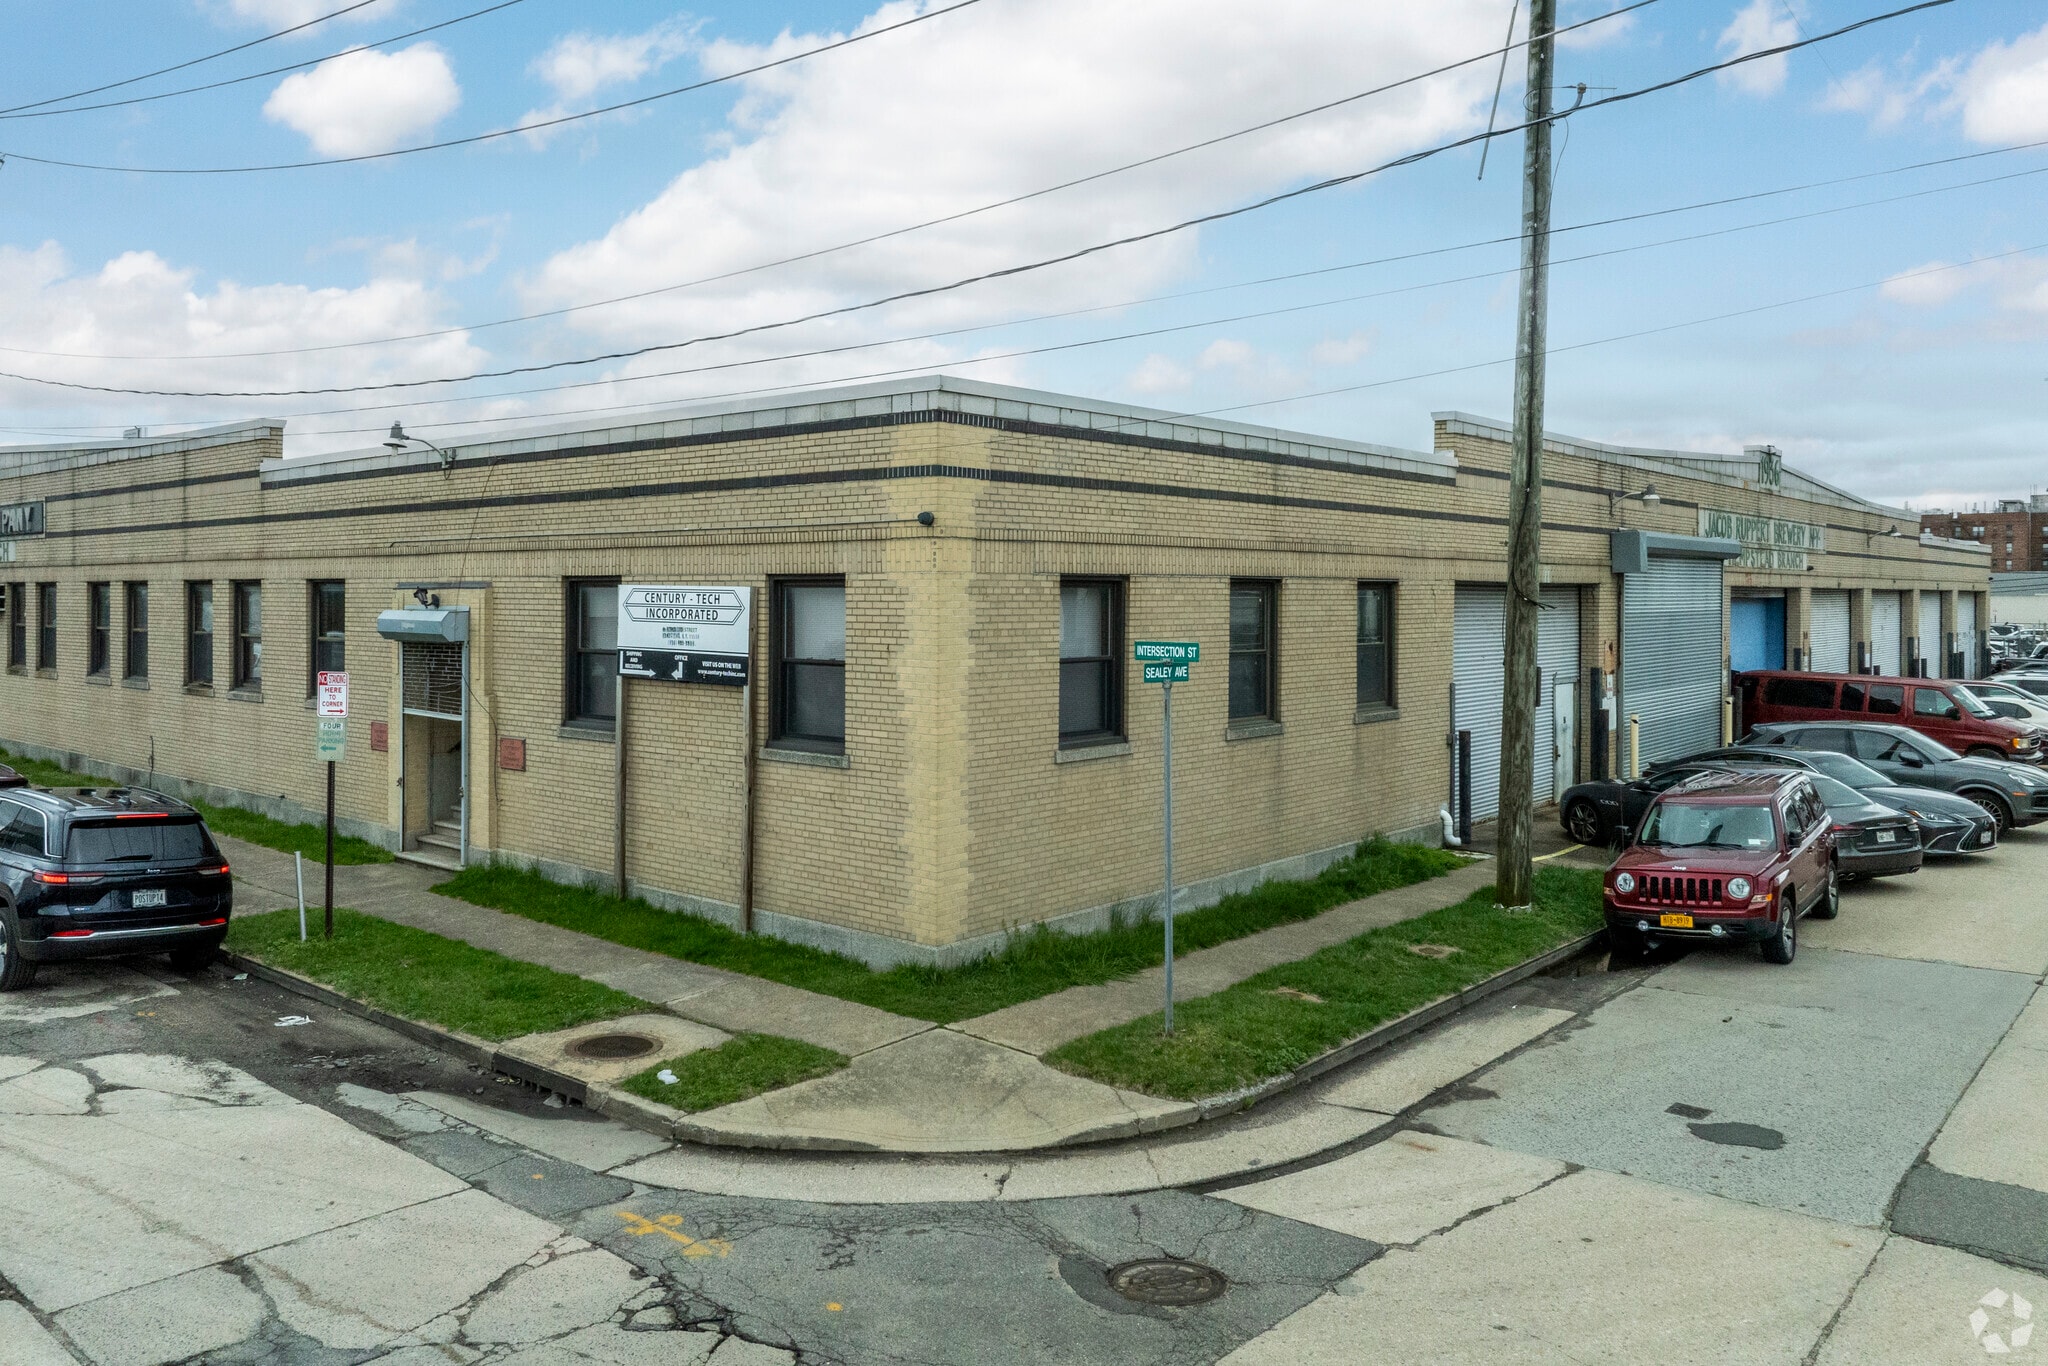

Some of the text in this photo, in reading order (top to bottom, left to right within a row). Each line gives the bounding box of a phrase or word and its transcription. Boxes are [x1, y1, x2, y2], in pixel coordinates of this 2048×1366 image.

[1705, 513, 1733, 540] JACOB
[1735, 516, 1770, 542] RUPPERT
[1773, 522, 1806, 546] BREWERY
[1777, 550, 1804, 569] BRANCH
[644, 592, 687, 604] CENTURY
[696, 593, 720, 605] TECH
[645, 607, 719, 620] INCORPORATED
[1136, 645, 1197, 658] INTERSECTION ST
[1145, 666, 1187, 678] SEALEY AVE
[320, 674, 346, 685] NO STANDING
